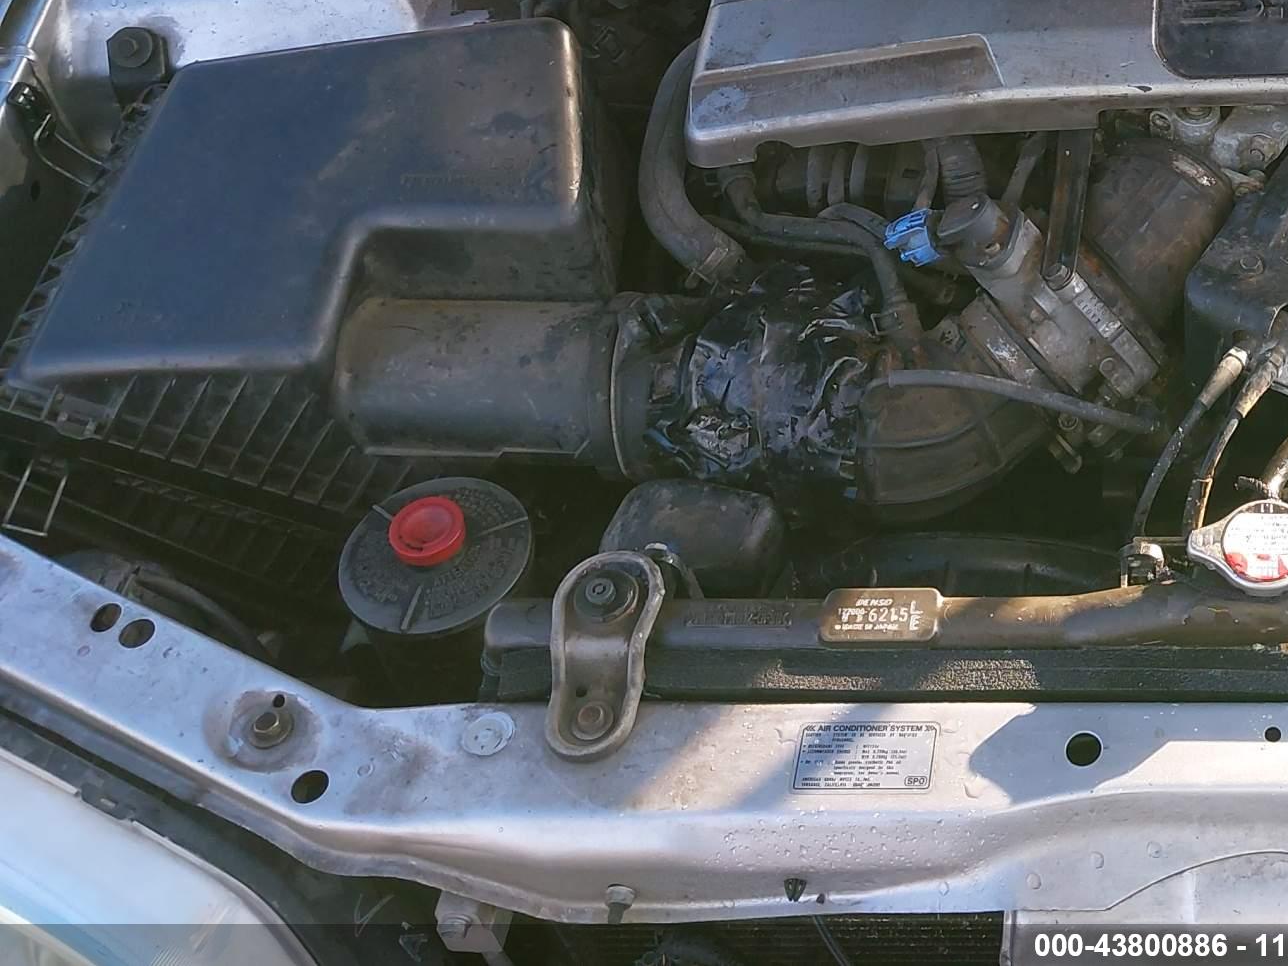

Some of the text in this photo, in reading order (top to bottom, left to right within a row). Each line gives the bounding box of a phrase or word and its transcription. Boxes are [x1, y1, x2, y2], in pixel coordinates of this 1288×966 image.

[855, 597, 894, 607] DENSO
[817, 724, 923, 732] AIR CONDITIONER SYSTEM
[906, 777, 926, 786] SPO
